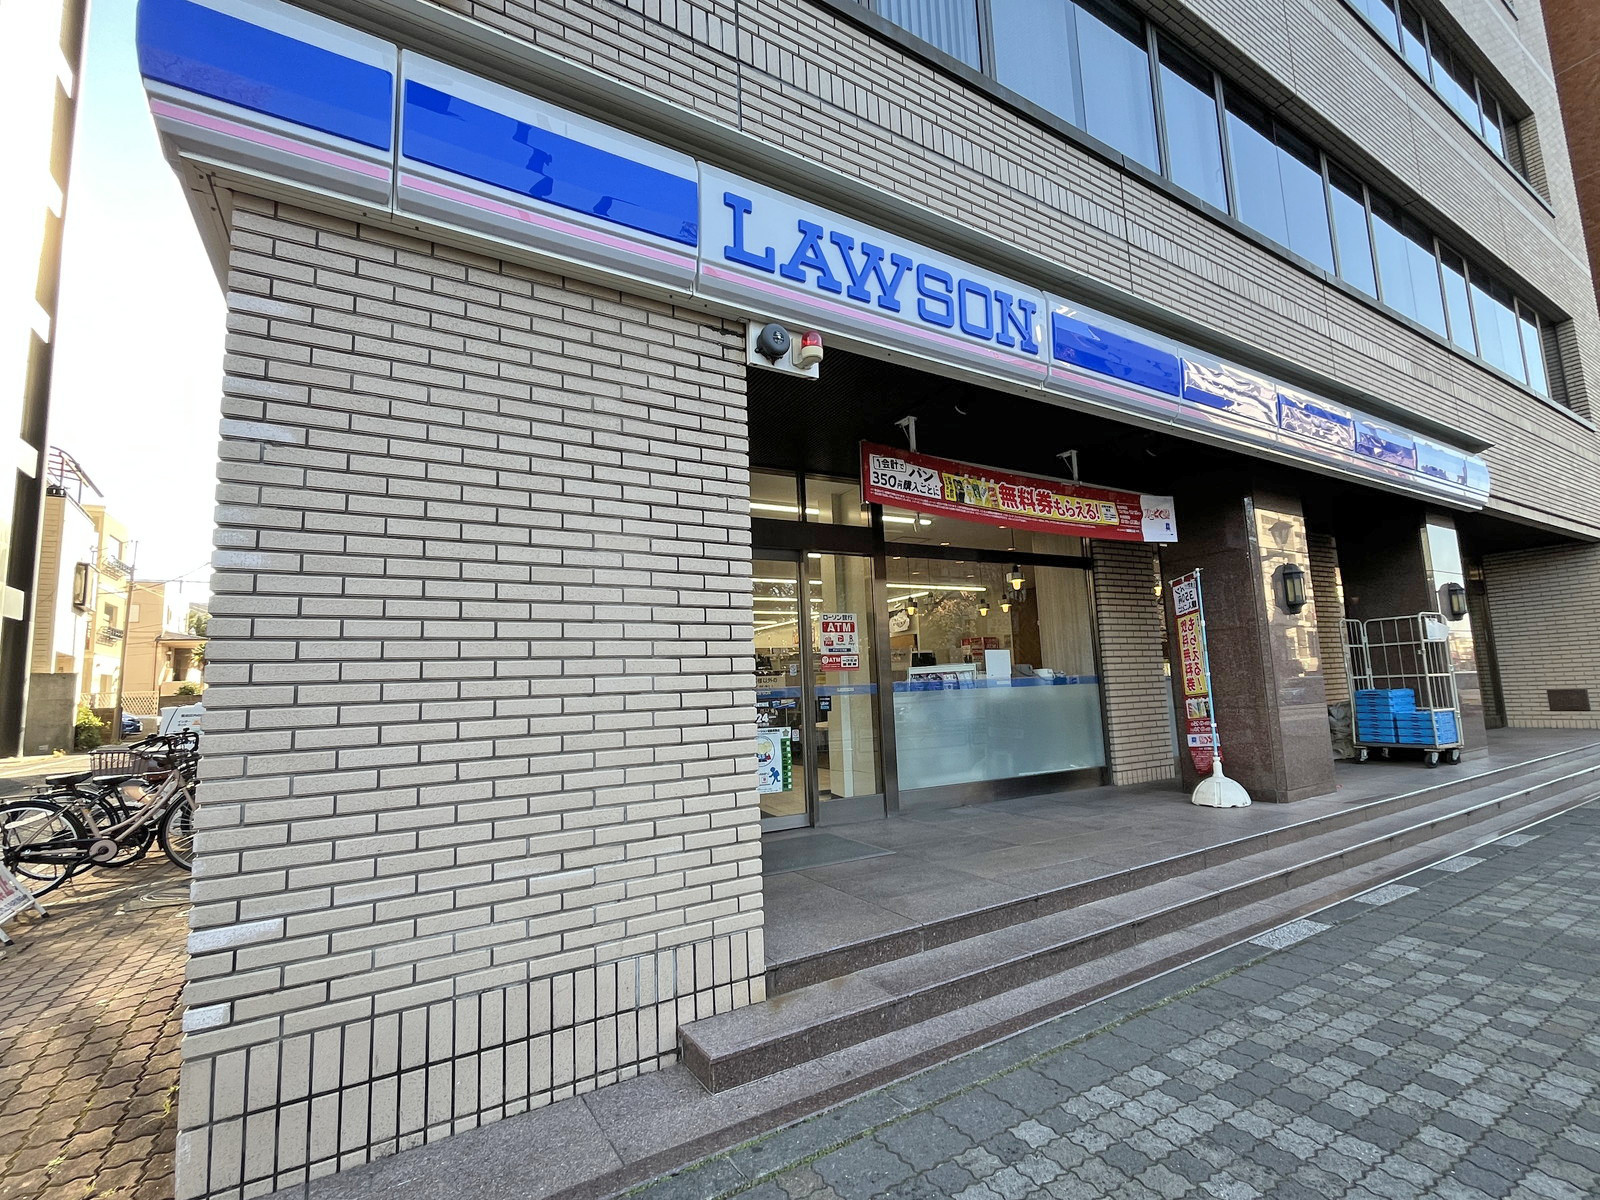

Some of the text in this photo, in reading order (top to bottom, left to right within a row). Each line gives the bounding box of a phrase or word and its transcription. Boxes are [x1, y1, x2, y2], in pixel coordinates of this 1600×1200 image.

[722, 191, 1038, 355] LAWSON
[876, 459, 905, 470] 1会計で
[908, 468, 934, 482] パン
[872, 471, 940, 497] 350円購入ごとに
[827, 622, 851, 632] ATM
[756, 713, 769, 723] 24
